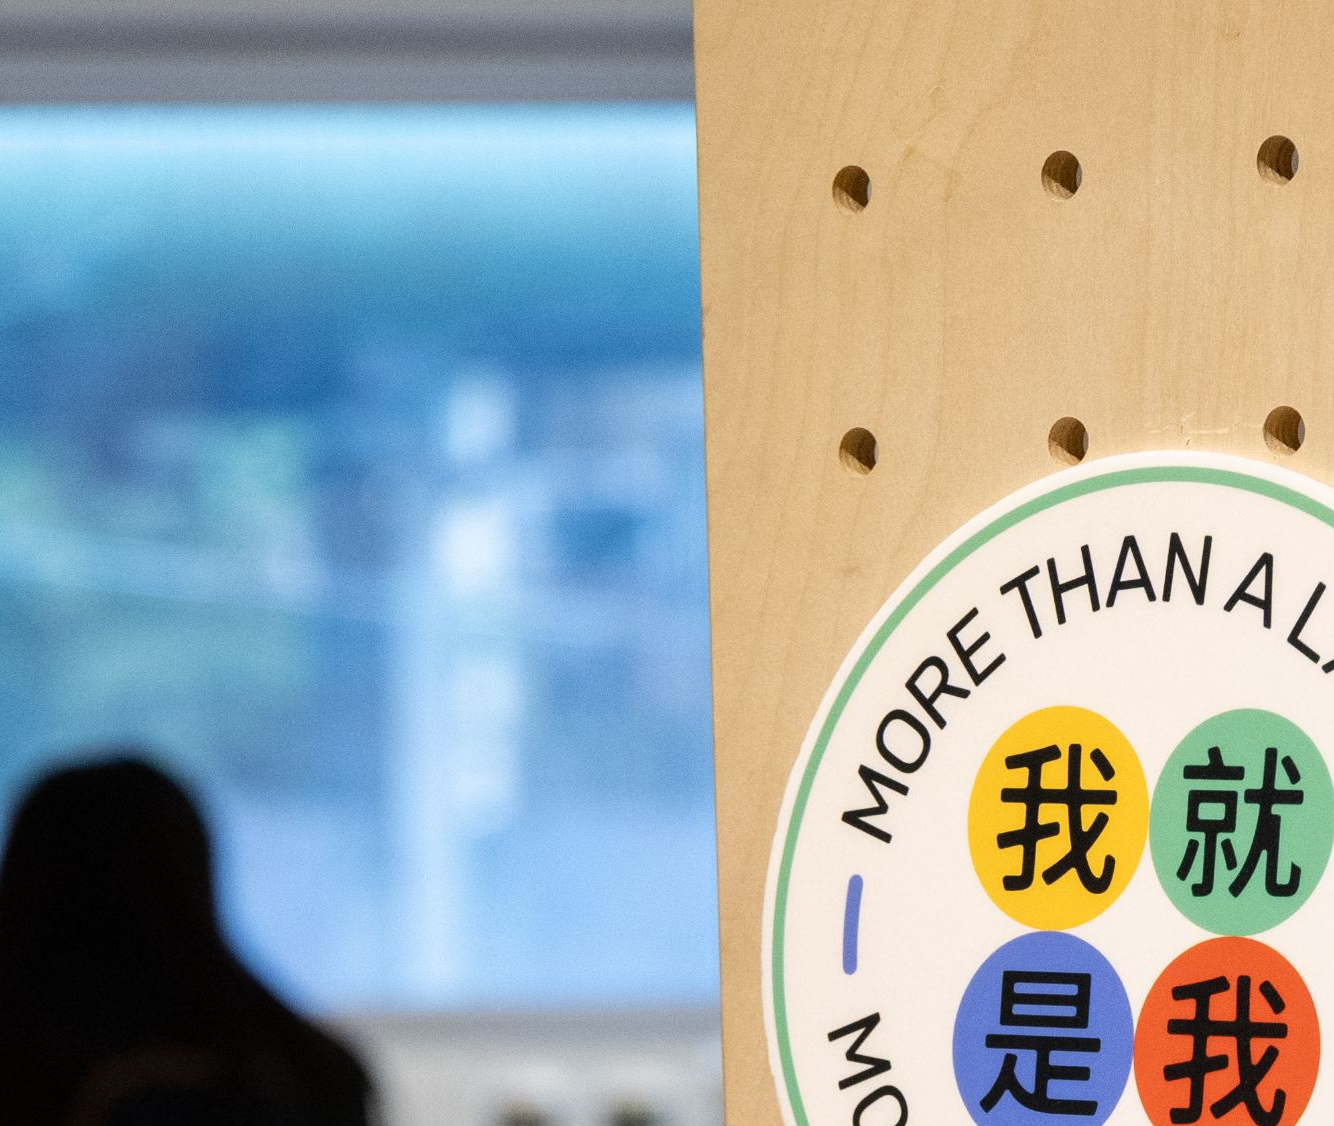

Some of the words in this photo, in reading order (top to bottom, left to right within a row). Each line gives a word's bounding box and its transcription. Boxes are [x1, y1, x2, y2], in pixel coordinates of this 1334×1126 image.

[841, 607, 1006, 845] MORE
[1000, 532, 1213, 640] THAN
[1223, 552, 1274, 629] A
